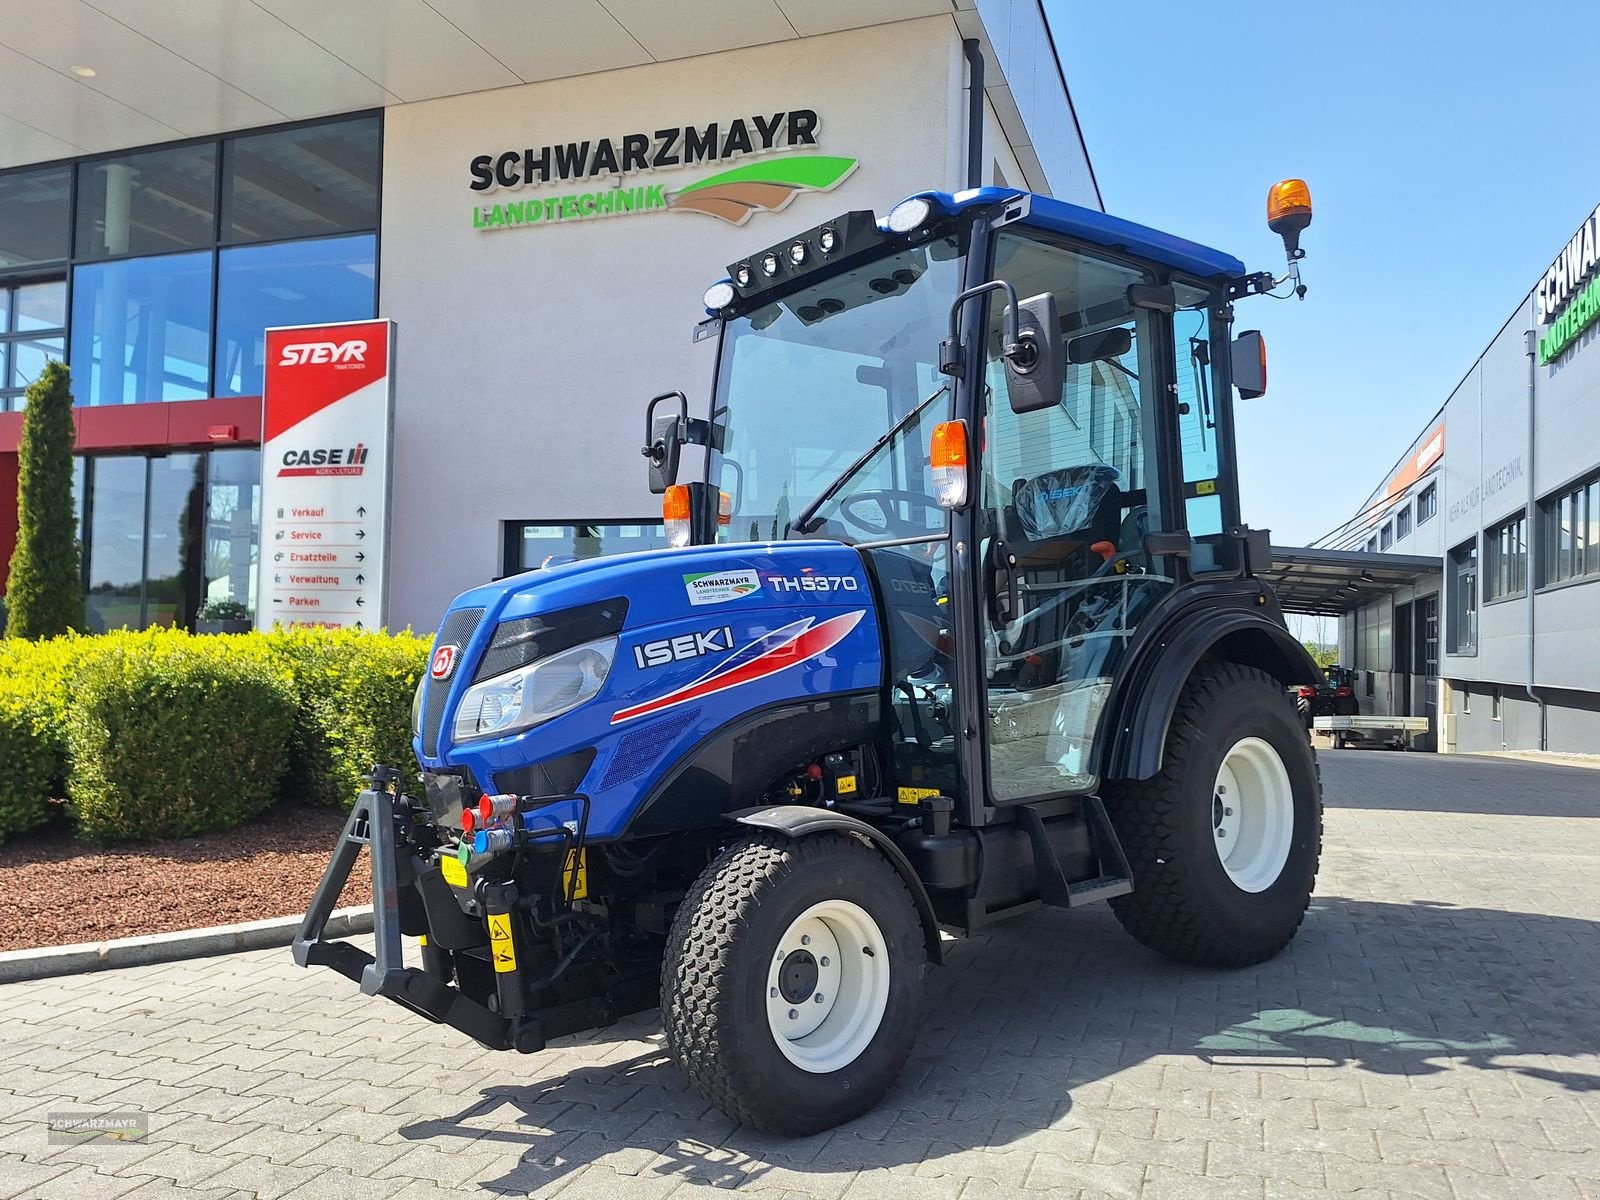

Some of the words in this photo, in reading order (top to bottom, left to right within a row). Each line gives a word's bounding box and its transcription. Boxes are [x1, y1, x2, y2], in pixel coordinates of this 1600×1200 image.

[469, 109, 818, 192] SCHWARZMAYR
[472, 184, 667, 229] LANDTECHNIK
[278, 340, 368, 366] STEYR
[282, 449, 343, 466] CASE
[292, 508, 324, 517] Verkauf
[291, 531, 322, 539] Service
[290, 553, 337, 561] Ersatzteile
[290, 575, 339, 585] Verwaltung
[693, 577, 750, 588] SCHWARZMAYR
[768, 576, 858, 592] TH5370
[289, 597, 320, 606] Parken
[633, 626, 735, 670] ISEKI
